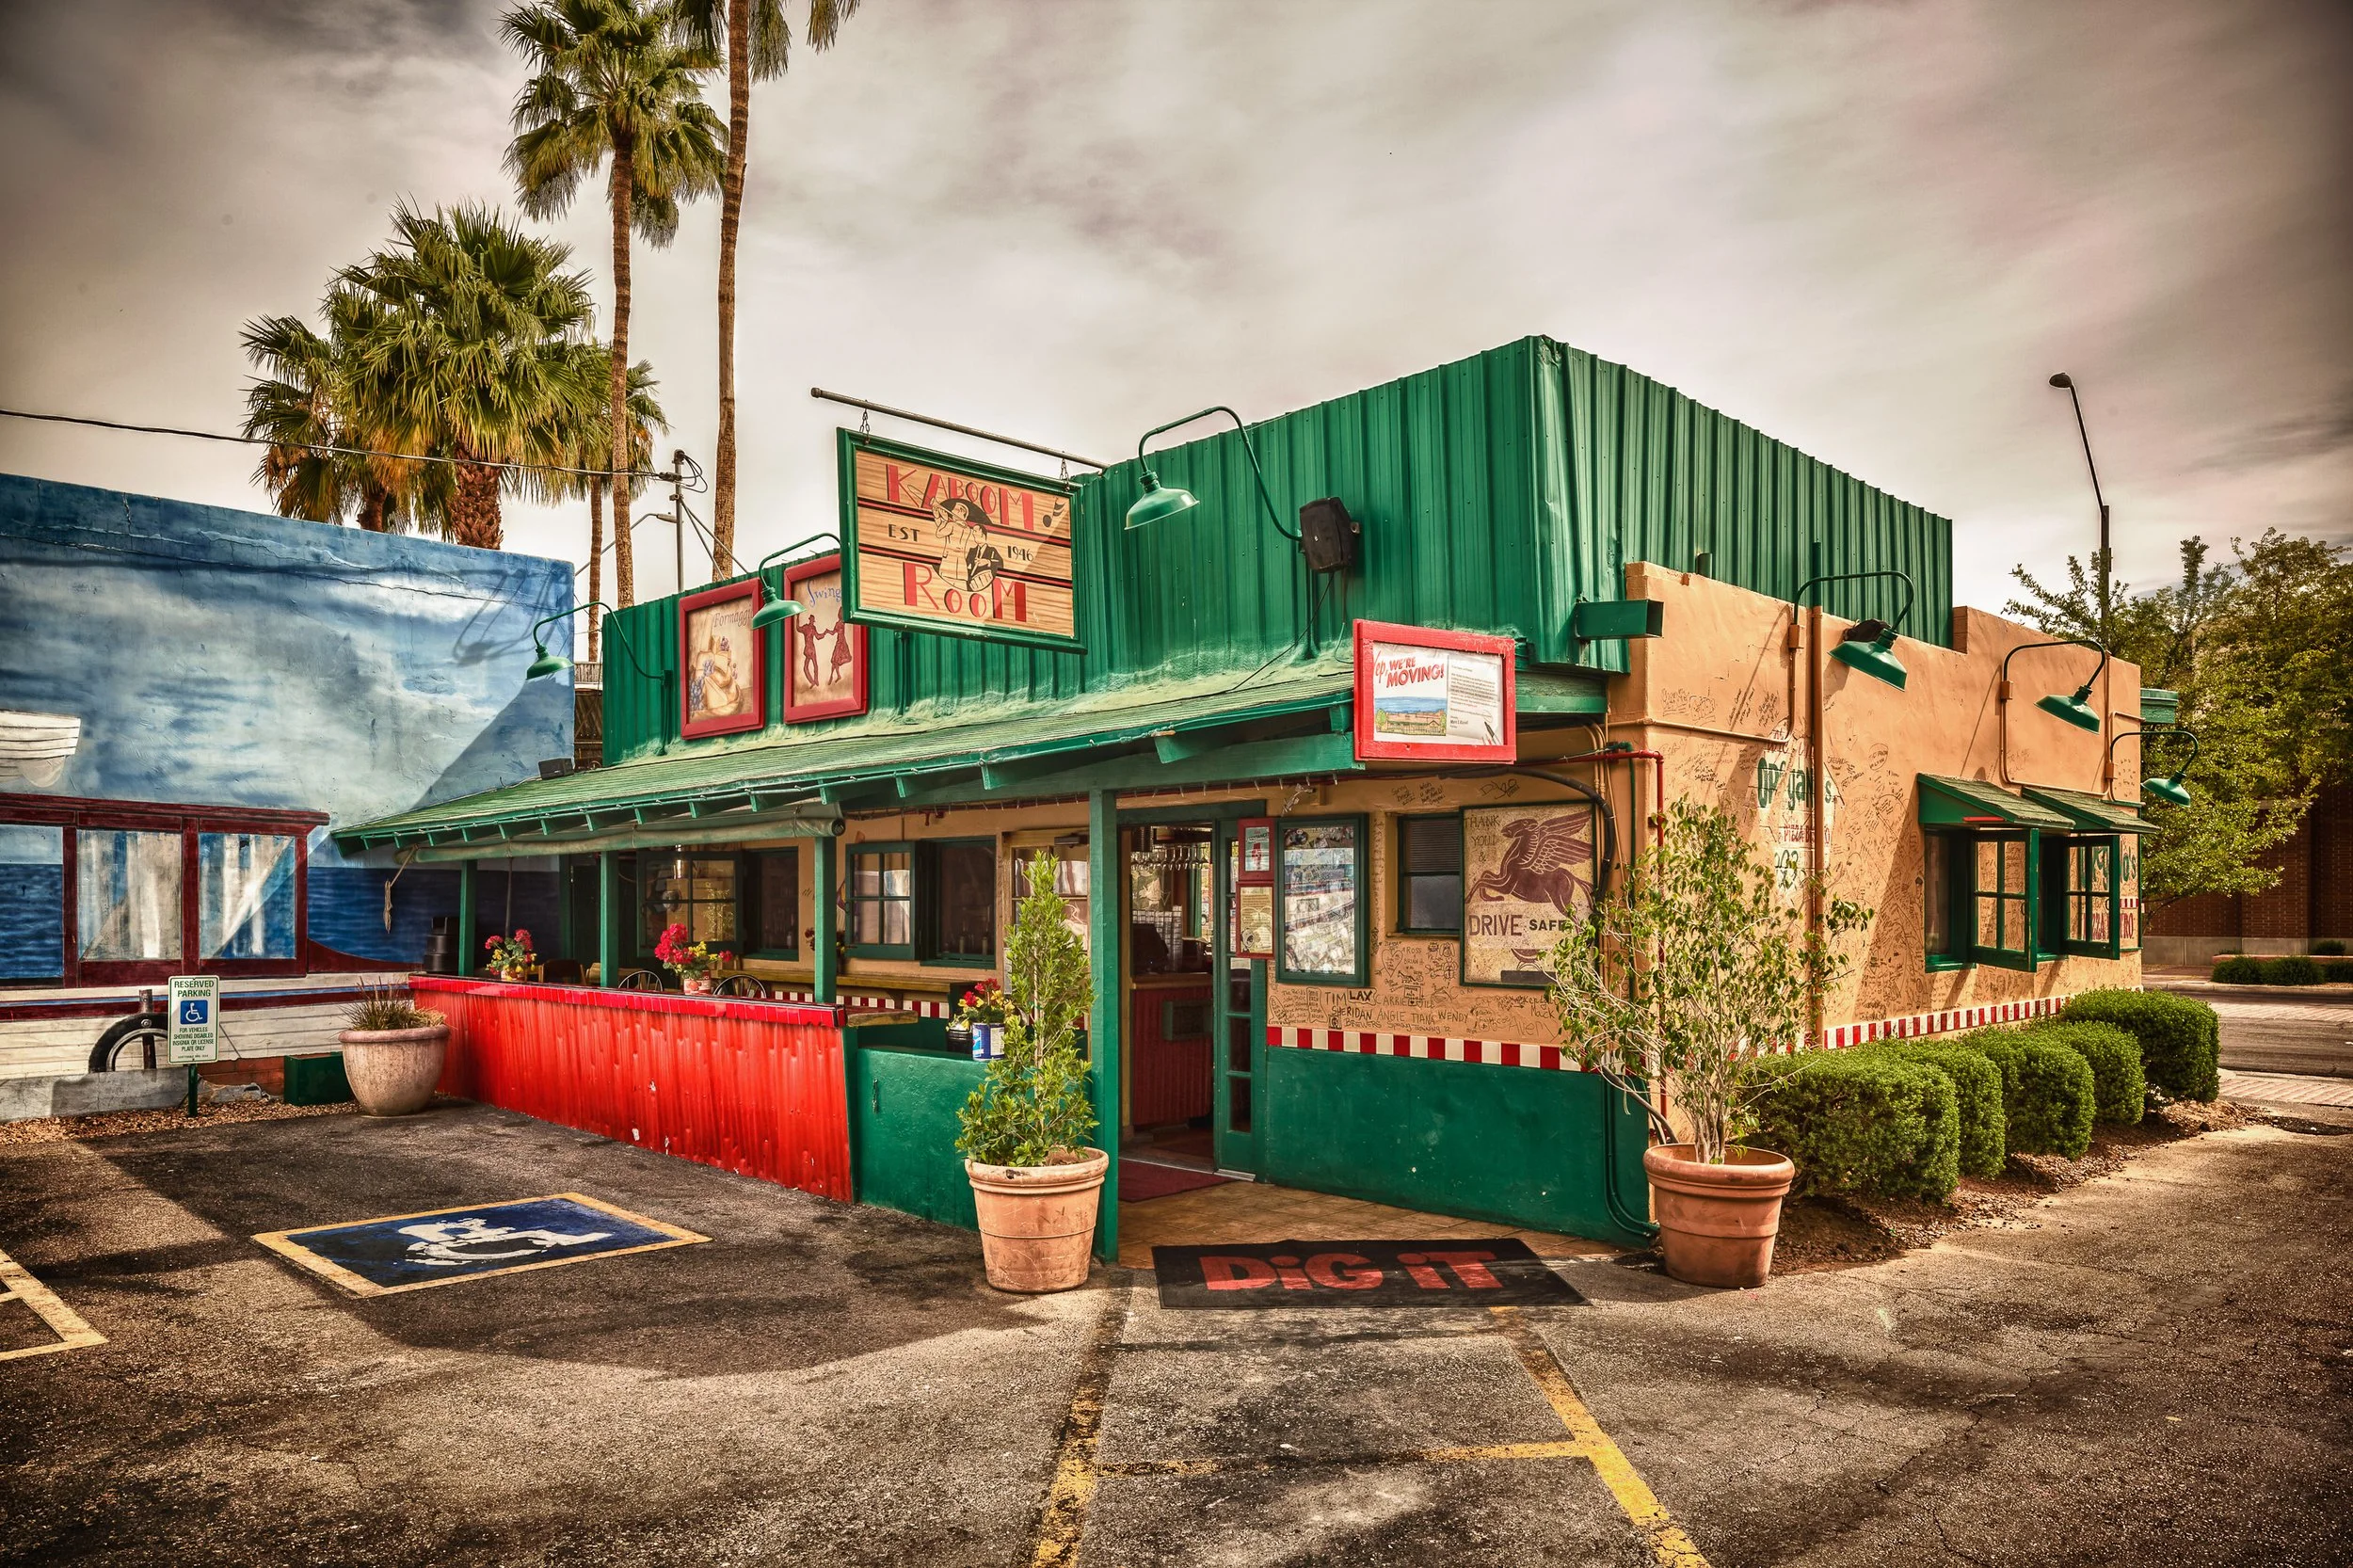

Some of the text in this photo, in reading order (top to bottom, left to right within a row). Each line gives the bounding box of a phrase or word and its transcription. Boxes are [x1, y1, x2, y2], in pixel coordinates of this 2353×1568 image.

[886, 464, 1034, 531] KABOOM
[888, 523, 1034, 562] EST 1946
[807, 581, 842, 608] Swing
[903, 562, 1027, 623] ROOM
[1389, 657, 1416, 671] WE'RE
[1386, 663, 1446, 688] MOVING!
[1464, 815, 1500, 828] THANK
[1468, 914, 1523, 936] DRIVE
[174, 980, 215, 988] RESERVED
[177, 989, 212, 998] PARKING
[1324, 991, 1347, 1006] TIM
[1349, 990, 1373, 1001] LAX
[1375, 994, 1407, 1007] CARRIE
[1331, 1005, 1373, 1020] SHERIDAN
[1377, 1008, 1406, 1022] ANGIE
[1438, 1010, 1468, 1024] WENDY
[1198, 1251, 1504, 1291] DiG iT
